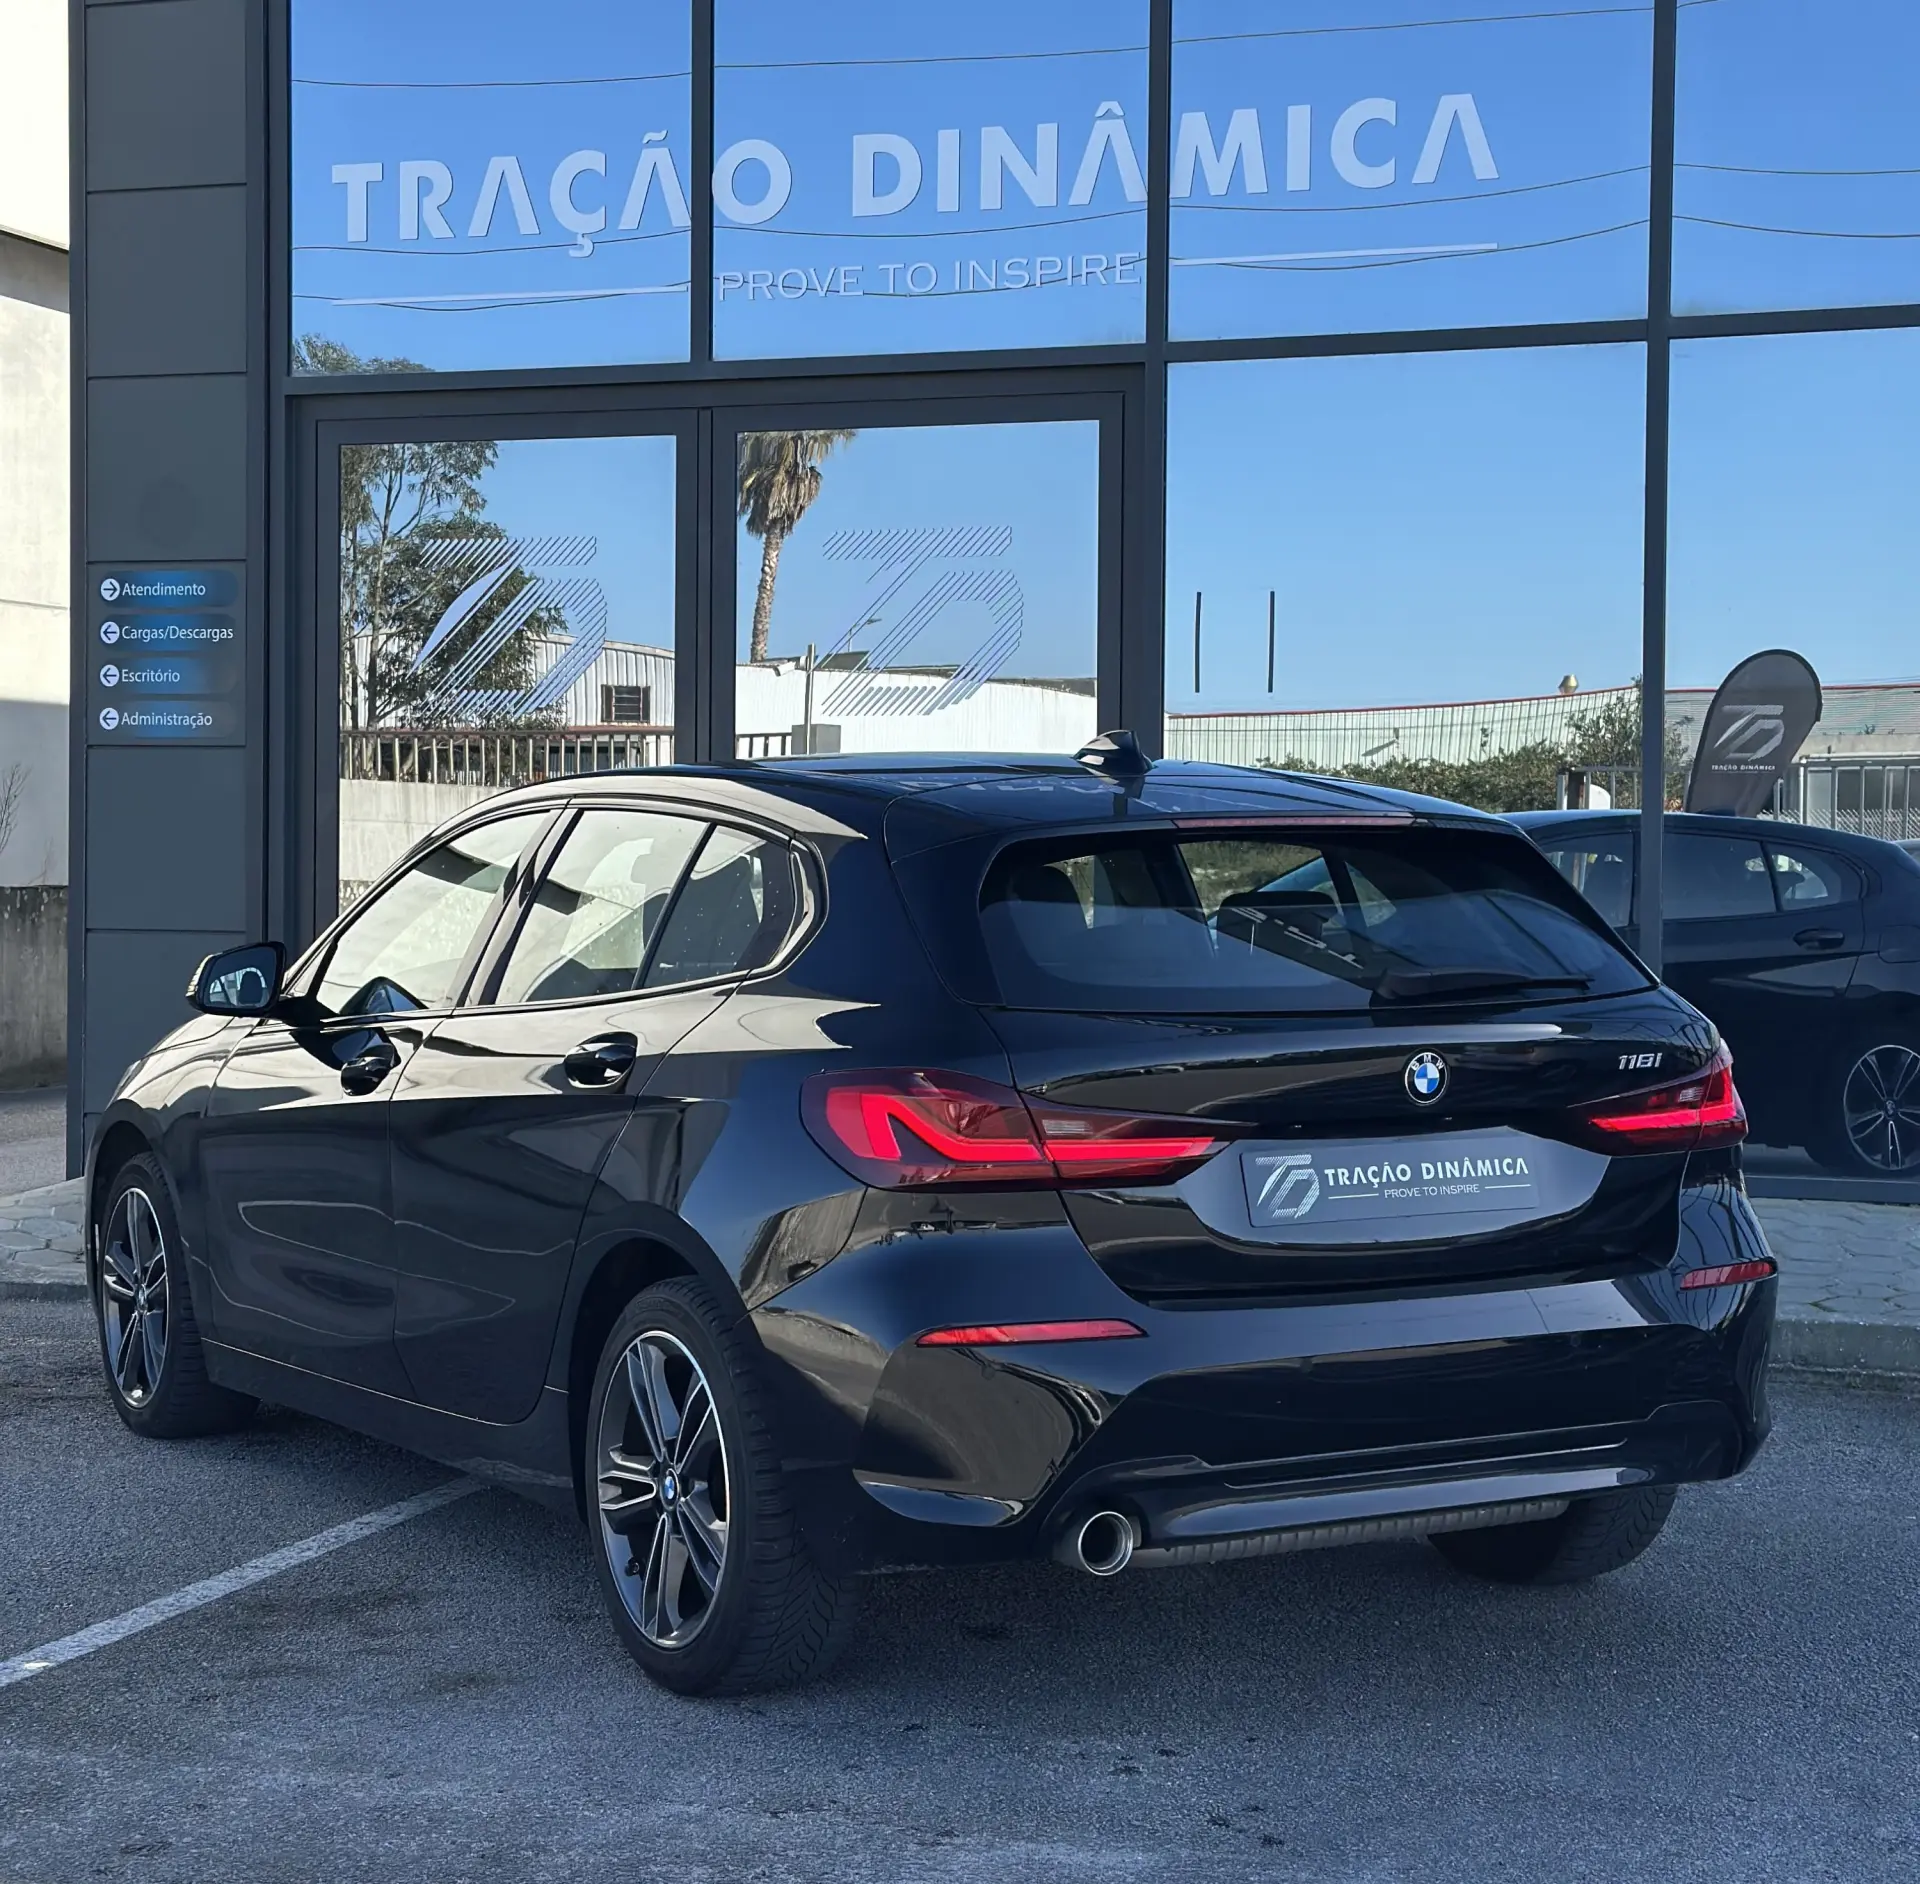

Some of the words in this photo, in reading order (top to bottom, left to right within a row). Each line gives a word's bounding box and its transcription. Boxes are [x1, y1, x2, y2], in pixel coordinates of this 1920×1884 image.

[331, 129, 793, 258] TRAÇÃO
[852, 92, 1500, 218] DINÂMICA
[718, 265, 864, 301] PROVE
[879, 261, 938, 295] TO
[954, 252, 1142, 291] INSPIRE
[122, 582, 206, 596] Atendimento
[121, 625, 234, 642] Cargas/Descargas
[121, 668, 181, 682] Escritório
[121, 712, 213, 729] Administração
[1324, 1162, 1412, 1188] TRAÇÃO
[1421, 1157, 1529, 1180] DINÂMICA
[1384, 1186, 1421, 1199] PROVE
[1424, 1185, 1438, 1196] TO
[1440, 1183, 1481, 1195] INSPIRE
